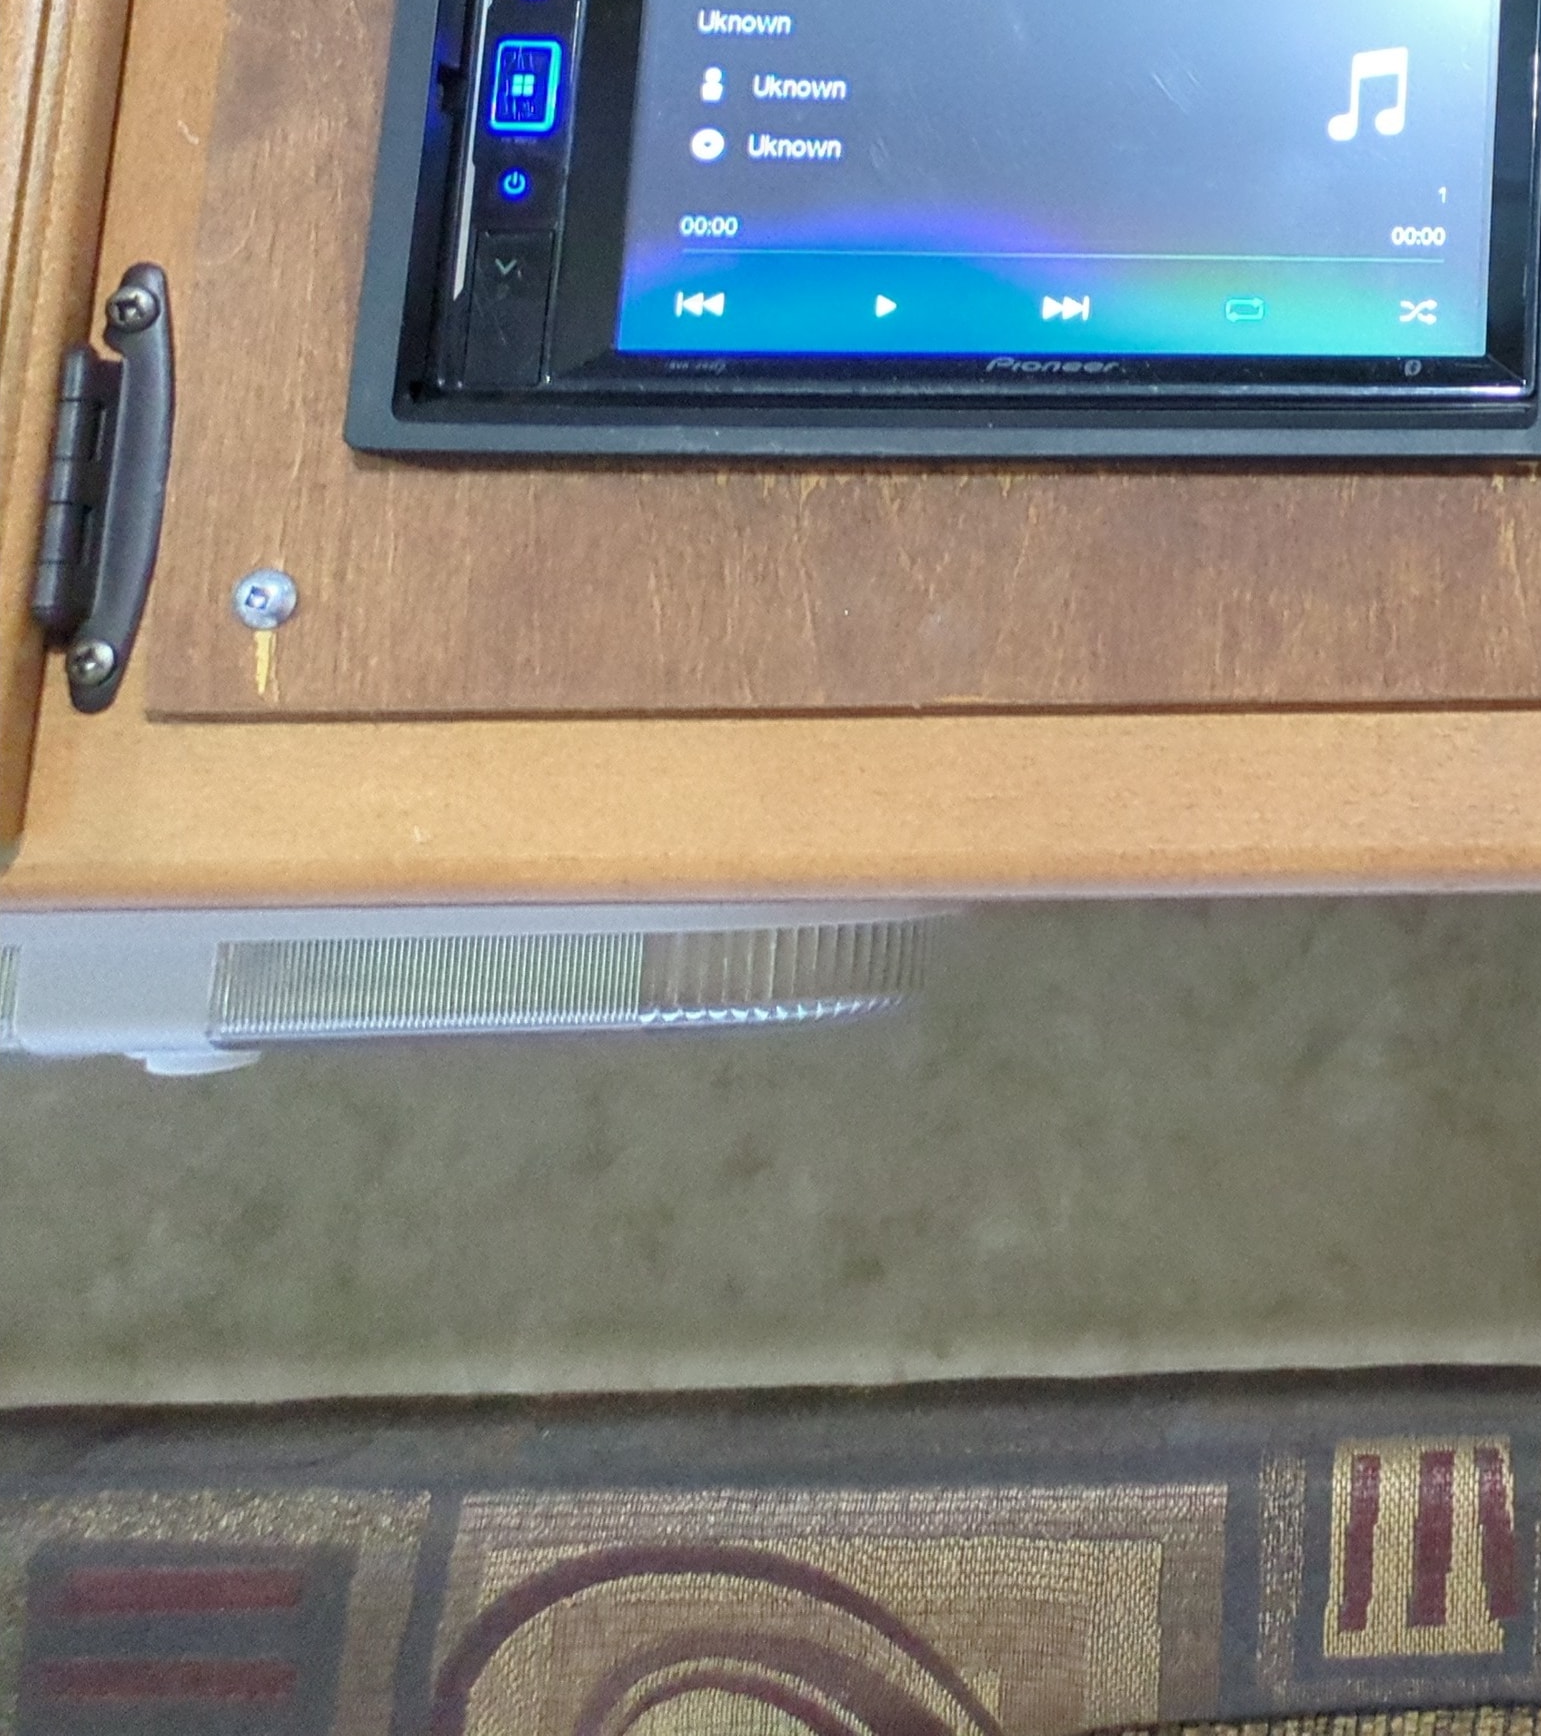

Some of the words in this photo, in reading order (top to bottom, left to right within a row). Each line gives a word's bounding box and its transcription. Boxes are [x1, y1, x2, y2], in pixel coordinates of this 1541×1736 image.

[697, 10, 792, 35] Uknown
[752, 75, 847, 102] Uknown
[747, 135, 842, 161] Uknown
[1438, 186, 1447, 204] 1
[680, 215, 739, 237] 00:00
[1391, 226, 1446, 246] 00:00
[986, 357, 1120, 374] Pioneer
